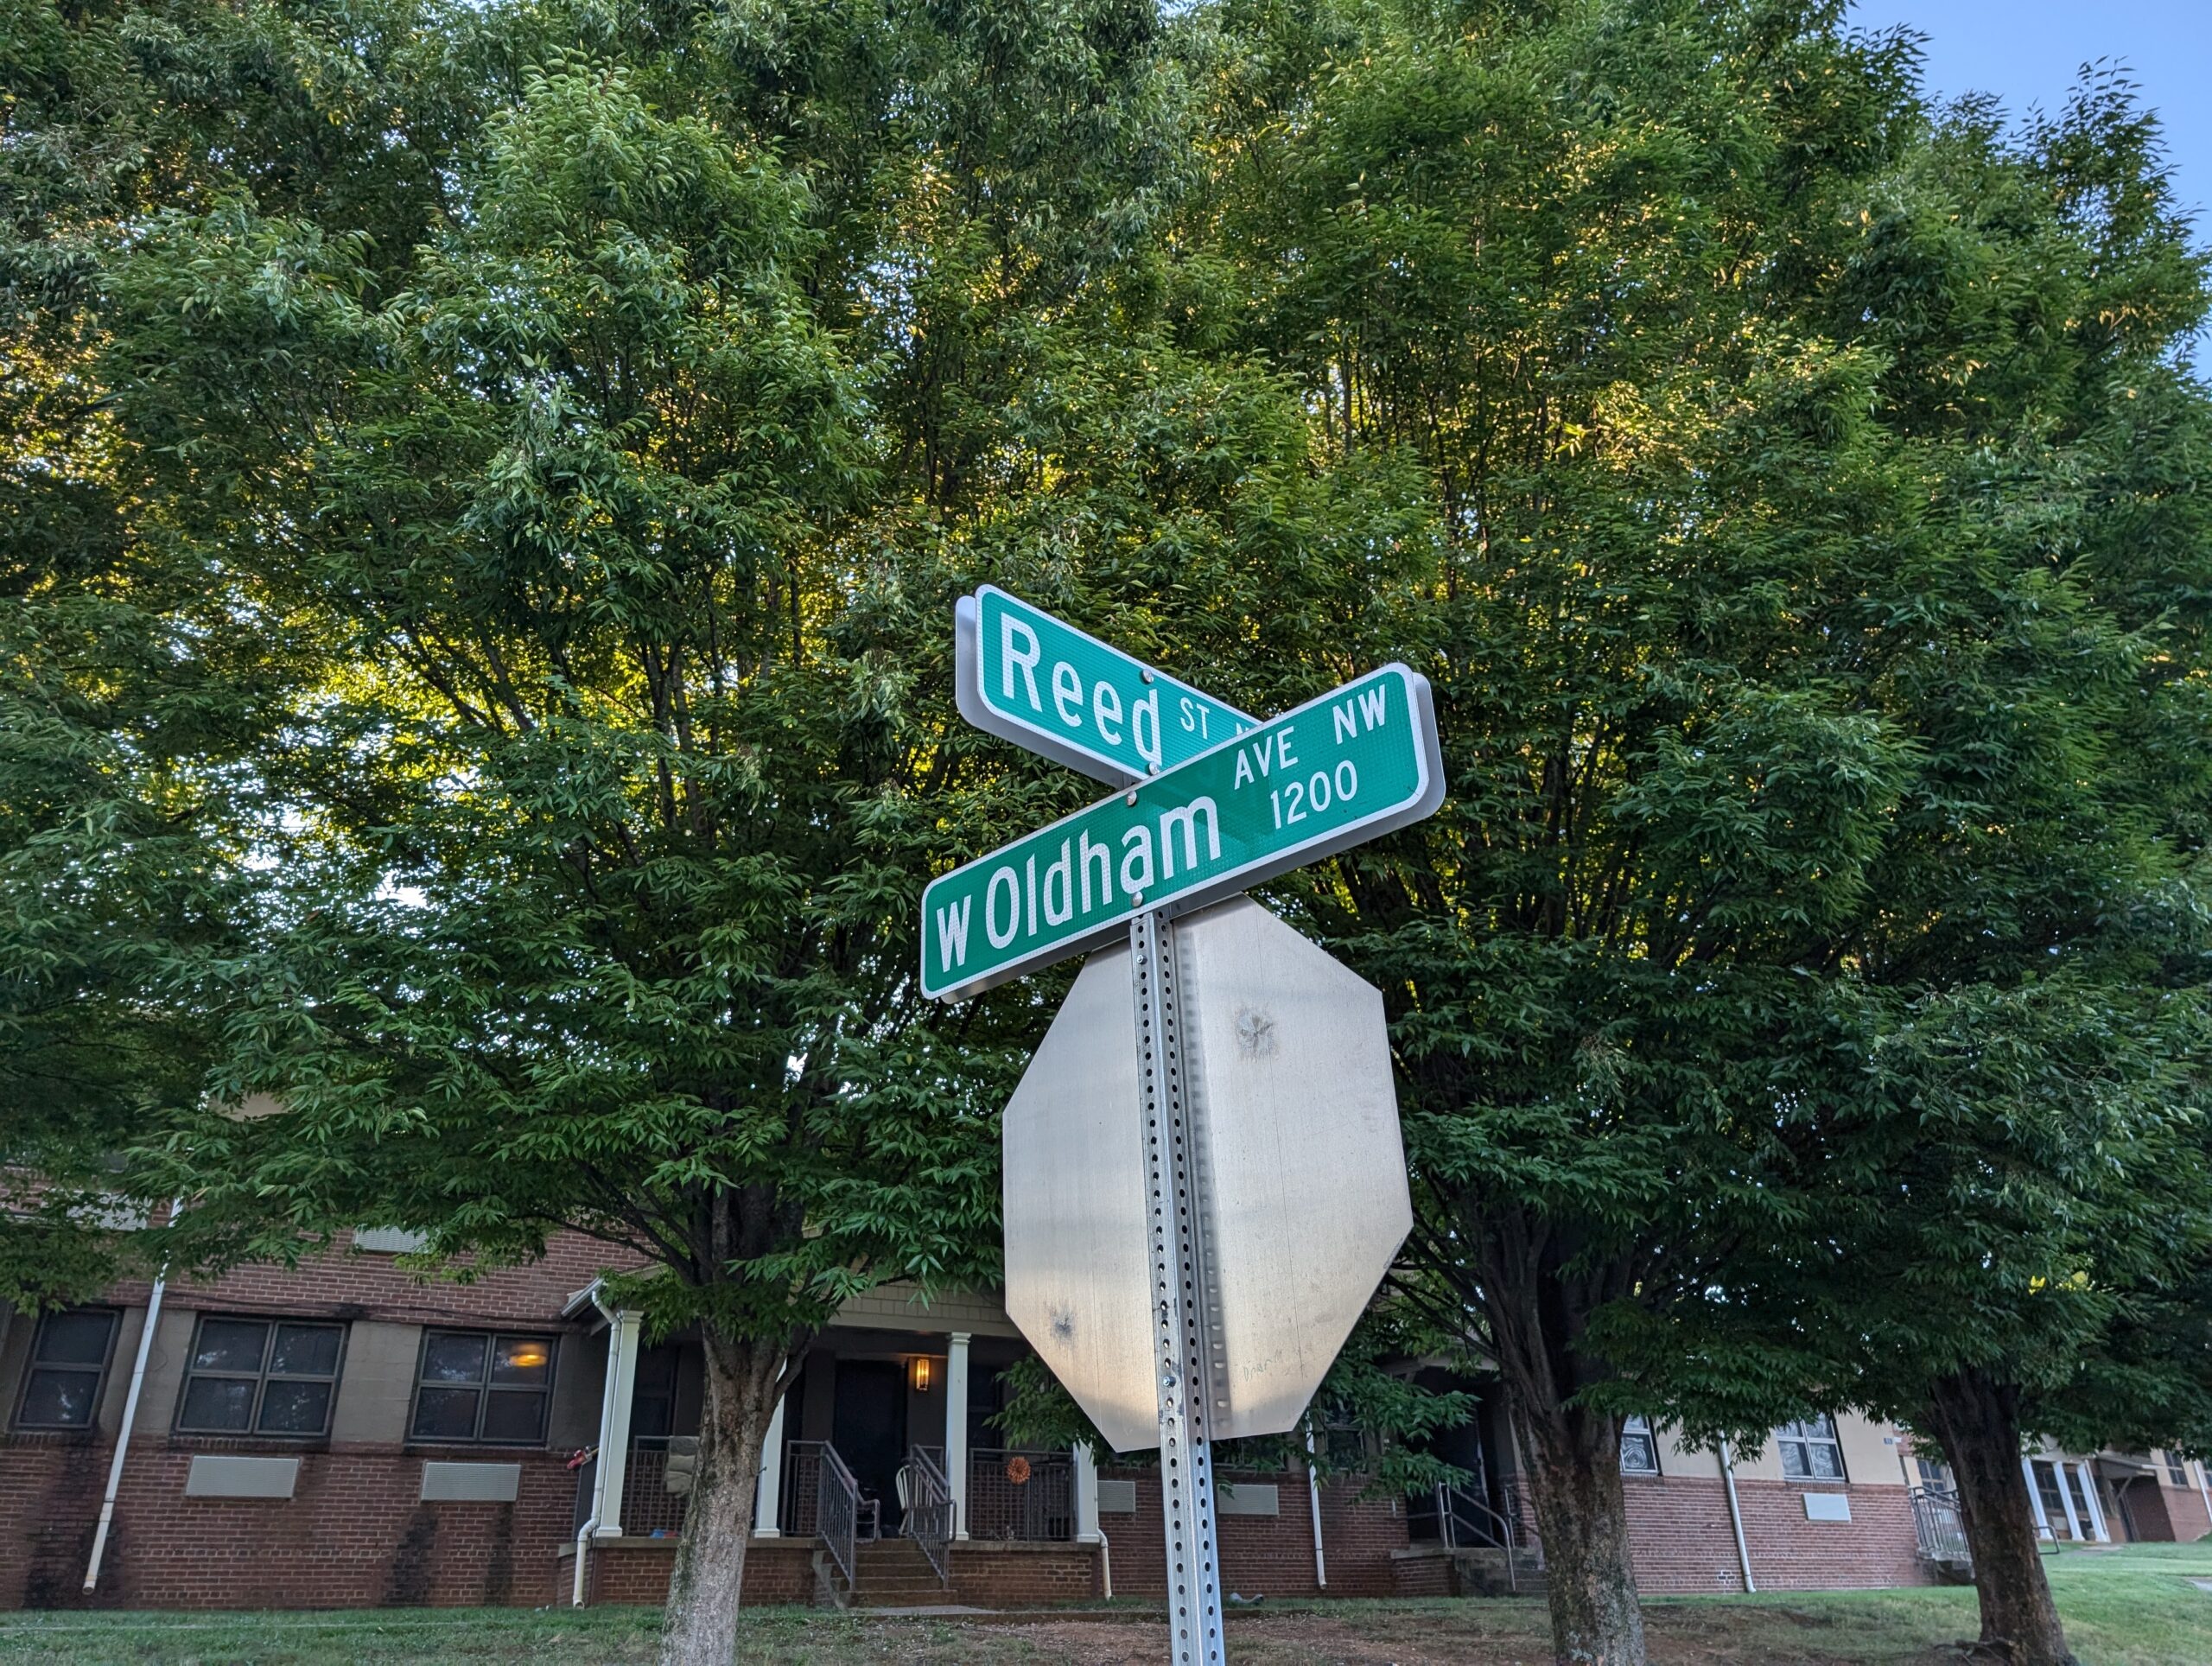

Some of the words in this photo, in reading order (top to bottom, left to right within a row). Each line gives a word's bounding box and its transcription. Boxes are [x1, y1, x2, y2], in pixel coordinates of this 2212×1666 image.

[1001, 612, 1163, 766] Reed
[1180, 696, 1210, 739] ST
[937, 894, 972, 974] W
[985, 795, 1223, 950] Oldham
[1235, 726, 1298, 790] AVE
[1333, 684, 1387, 745] NW
[1270, 760, 1358, 830] 1200
